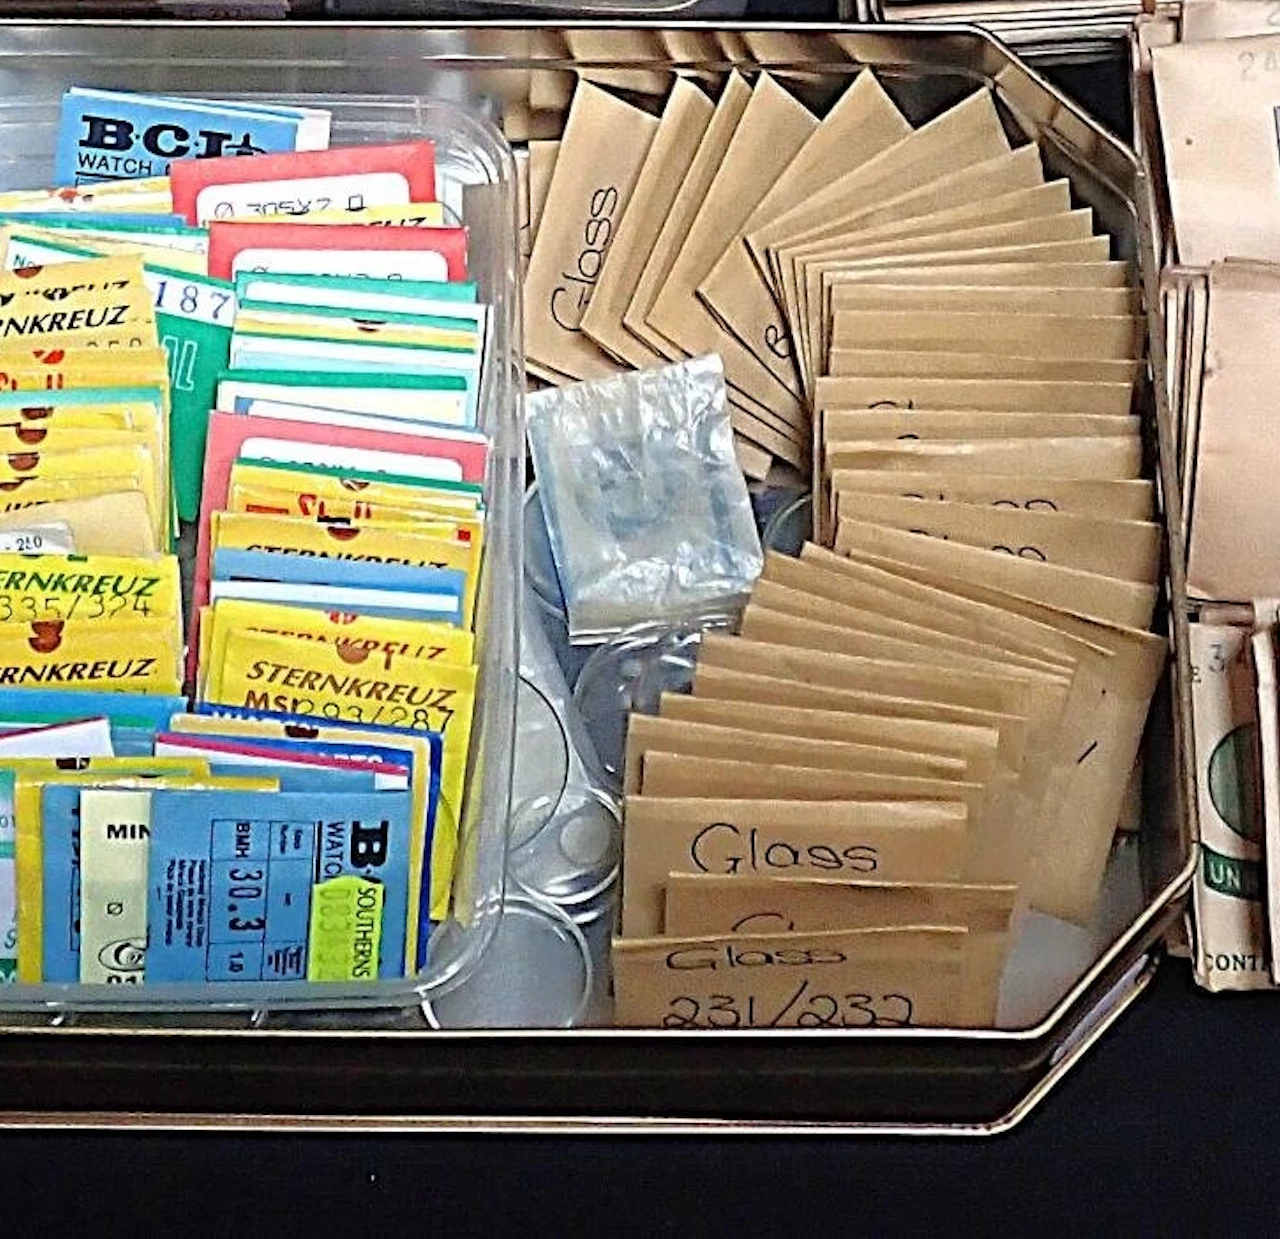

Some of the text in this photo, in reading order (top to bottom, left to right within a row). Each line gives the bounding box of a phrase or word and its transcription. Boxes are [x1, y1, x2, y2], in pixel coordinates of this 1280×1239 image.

[76, 151, 153, 176] WATCH
[550, 185, 619, 334] Glass
[245, 660, 457, 712] STERNKREUZ
[235, 822, 251, 858] BMH
[324, 821, 344, 879] WATC
[690, 822, 878, 875] Glass
[227, 868, 266, 932] 30.3
[352, 887, 377, 979] SOUTHERNS
[662, 978, 915, 1028] 231/232
